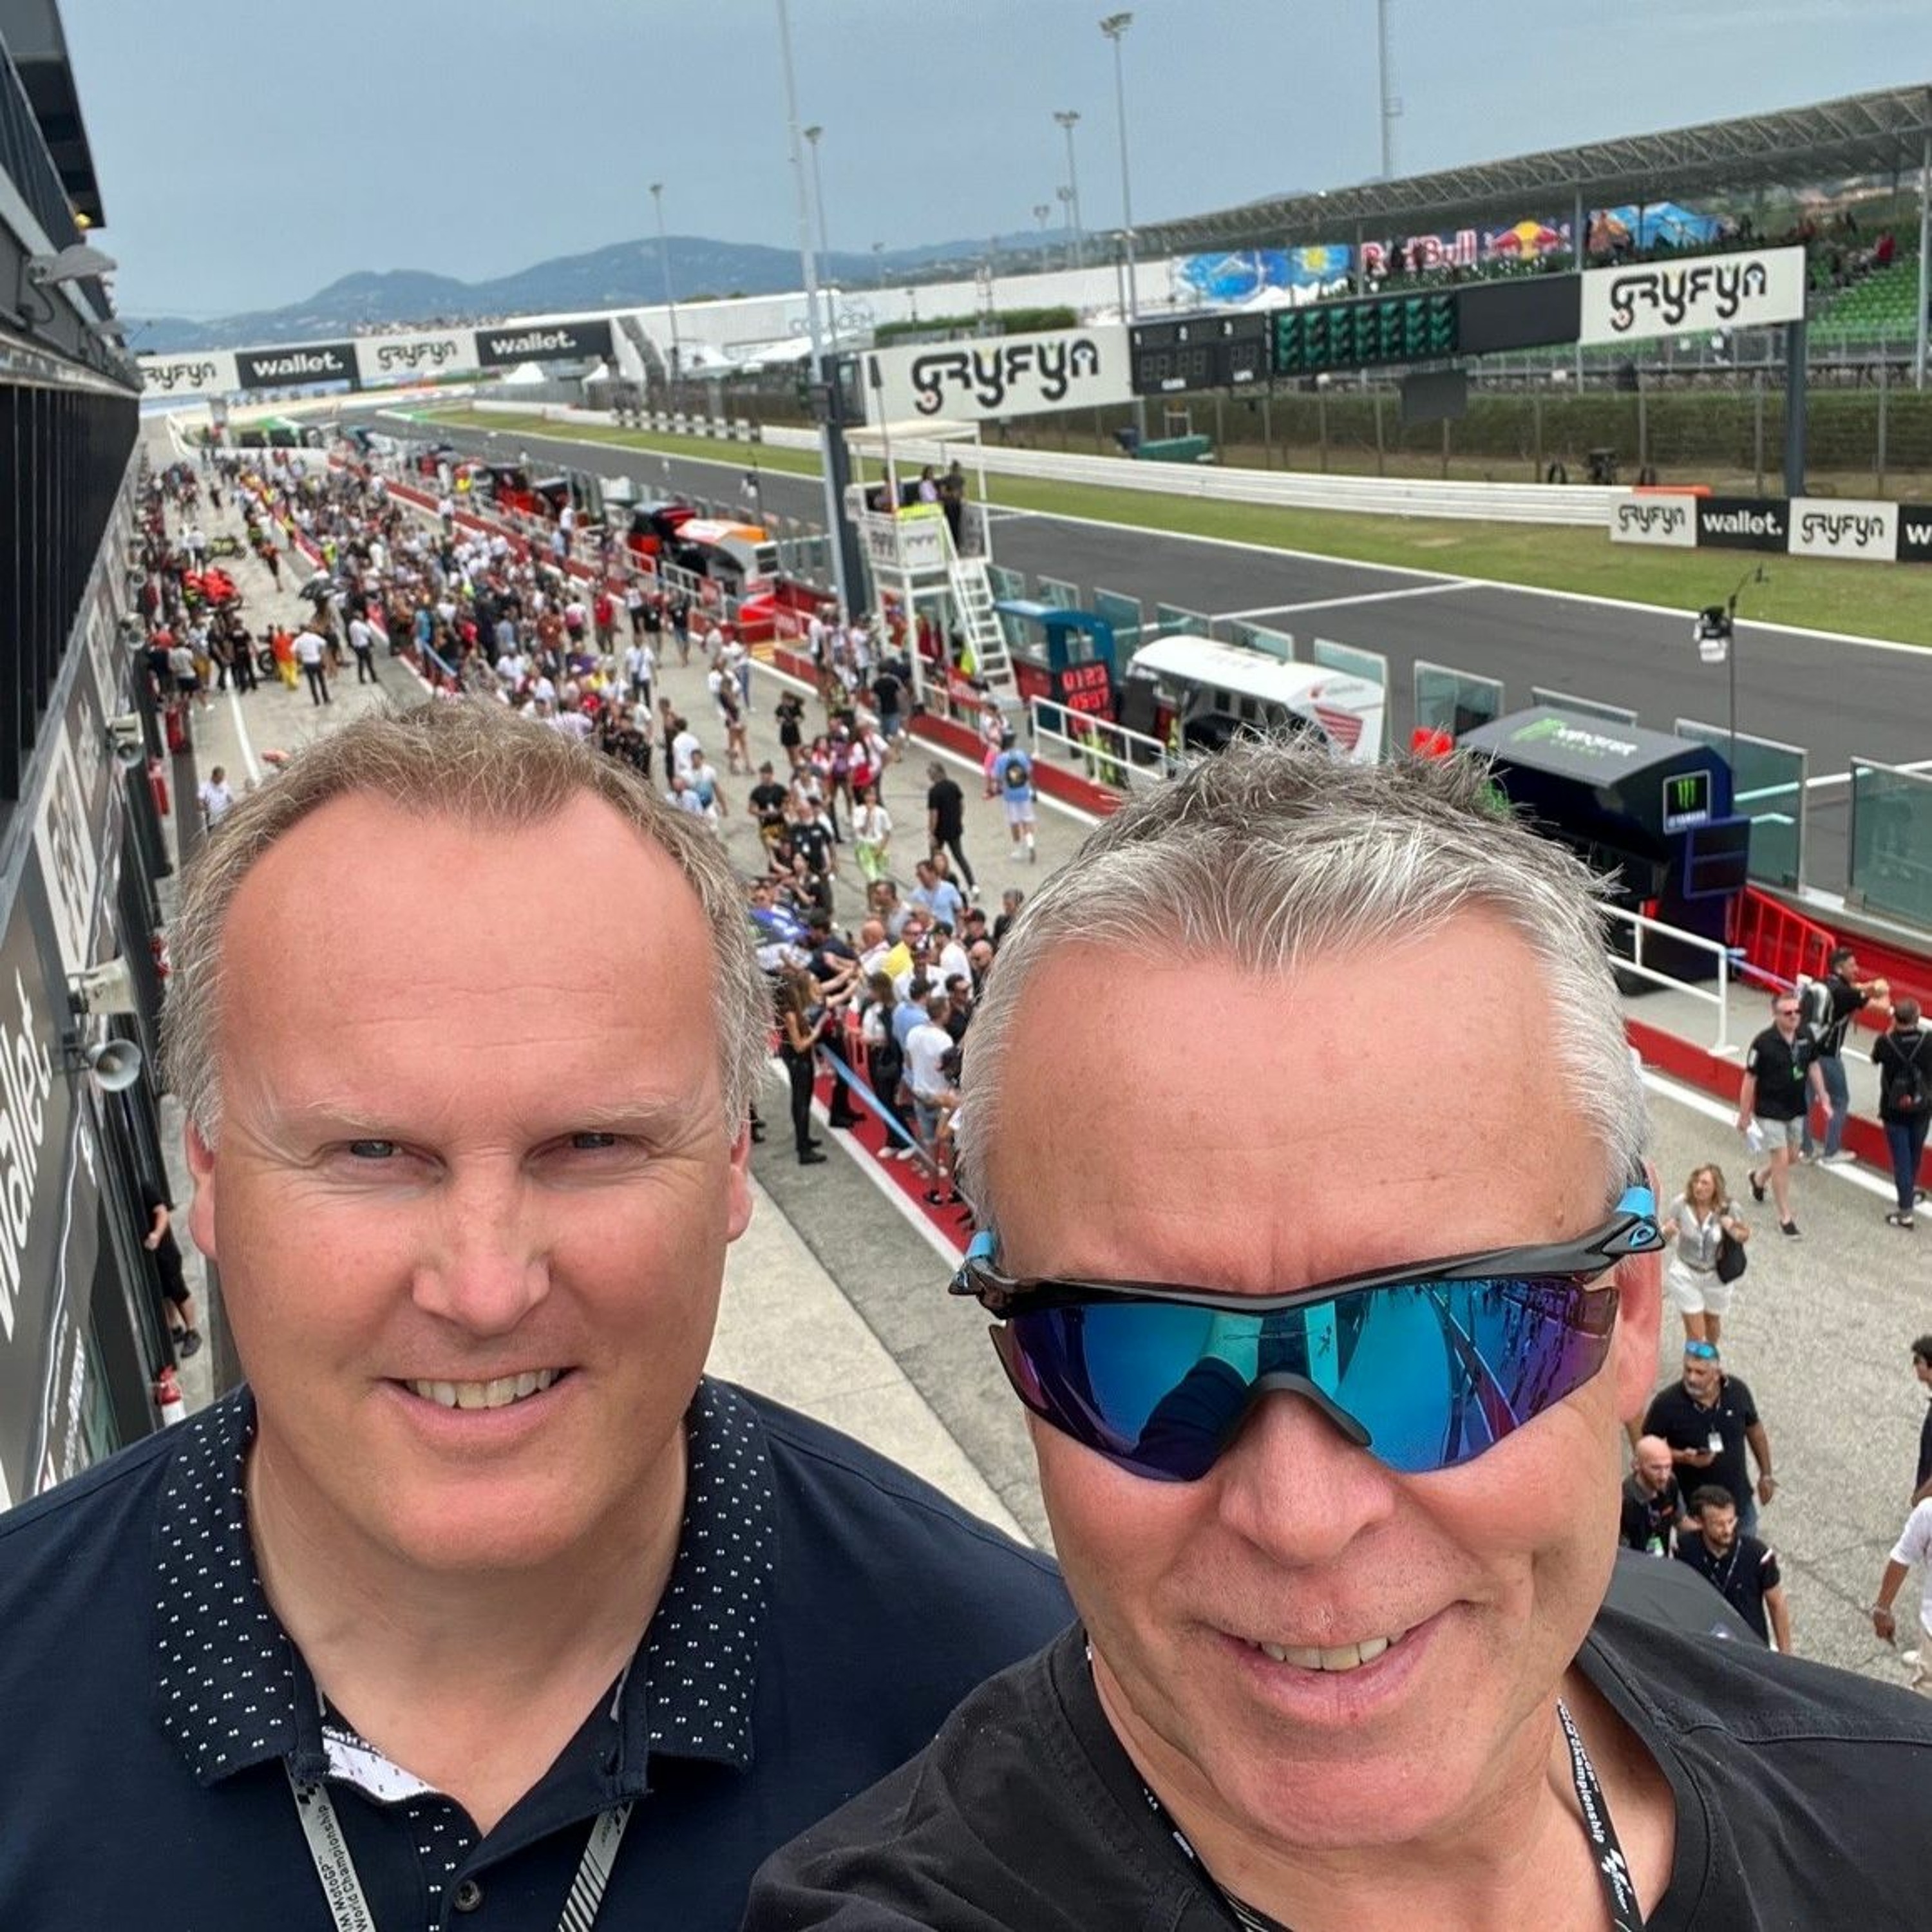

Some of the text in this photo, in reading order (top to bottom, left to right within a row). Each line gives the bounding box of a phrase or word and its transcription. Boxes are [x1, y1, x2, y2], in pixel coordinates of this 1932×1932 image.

[252, 352, 344, 376] wallet.
[1703, 510, 1783, 535] wallet.
[318, 1804, 354, 1893] Championship
